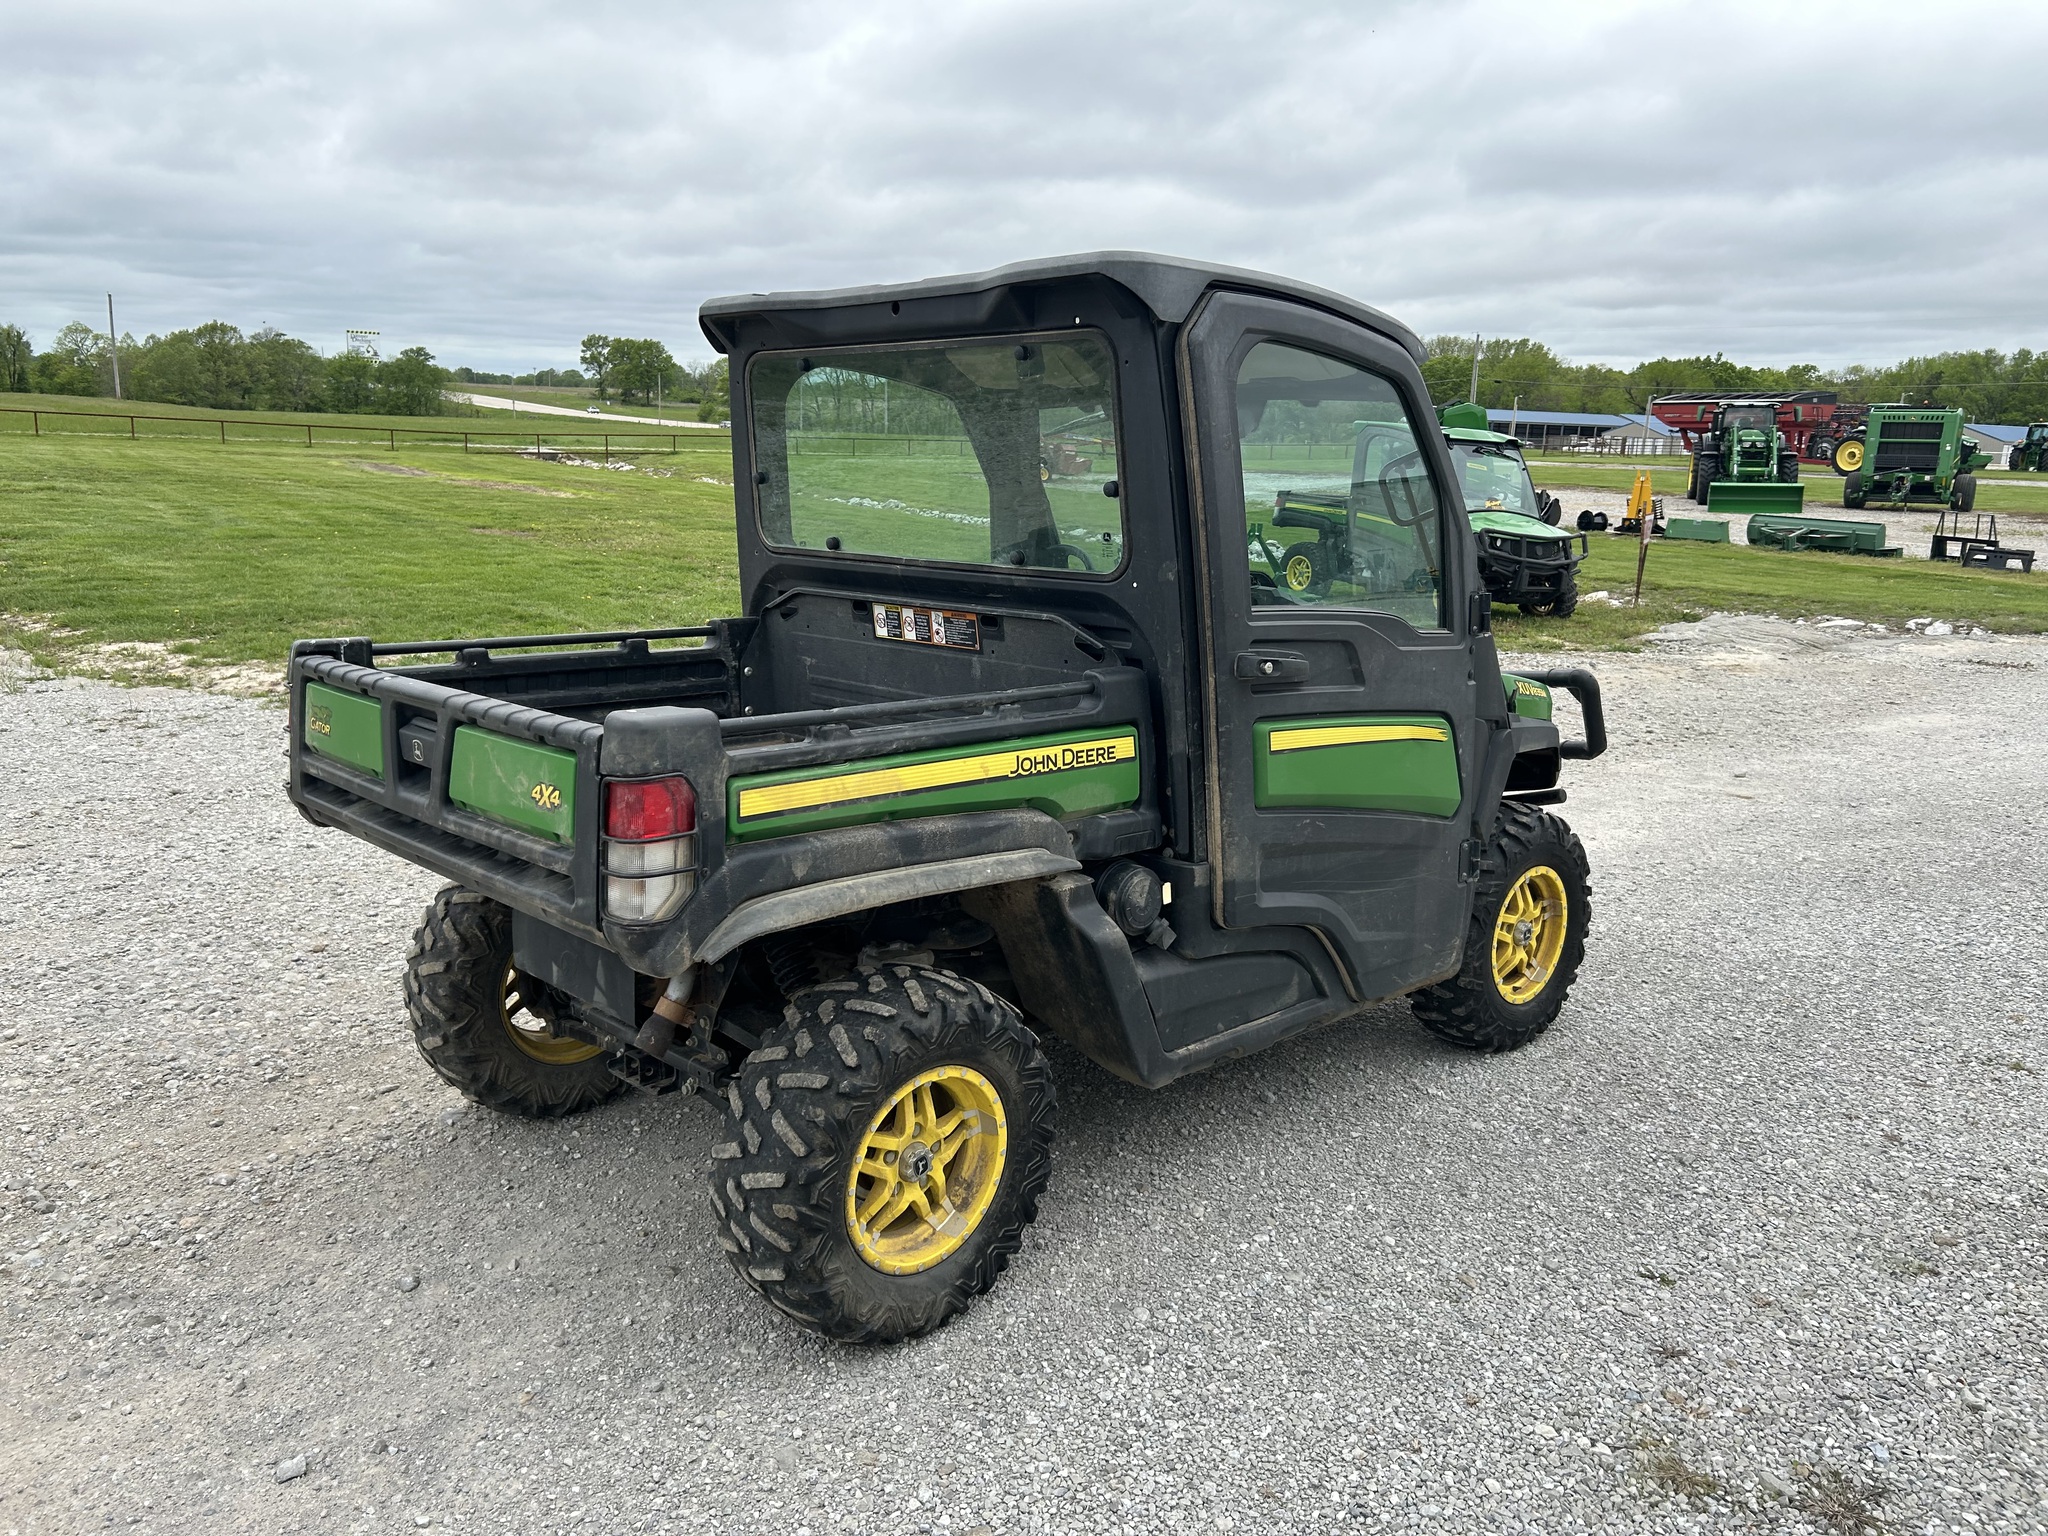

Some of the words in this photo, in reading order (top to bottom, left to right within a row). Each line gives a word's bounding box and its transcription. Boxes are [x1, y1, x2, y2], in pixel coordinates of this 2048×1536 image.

[310, 717, 331, 736] GATOR
[1009, 754, 1058, 775] JOHN
[1061, 745, 1117, 767] DEERE
